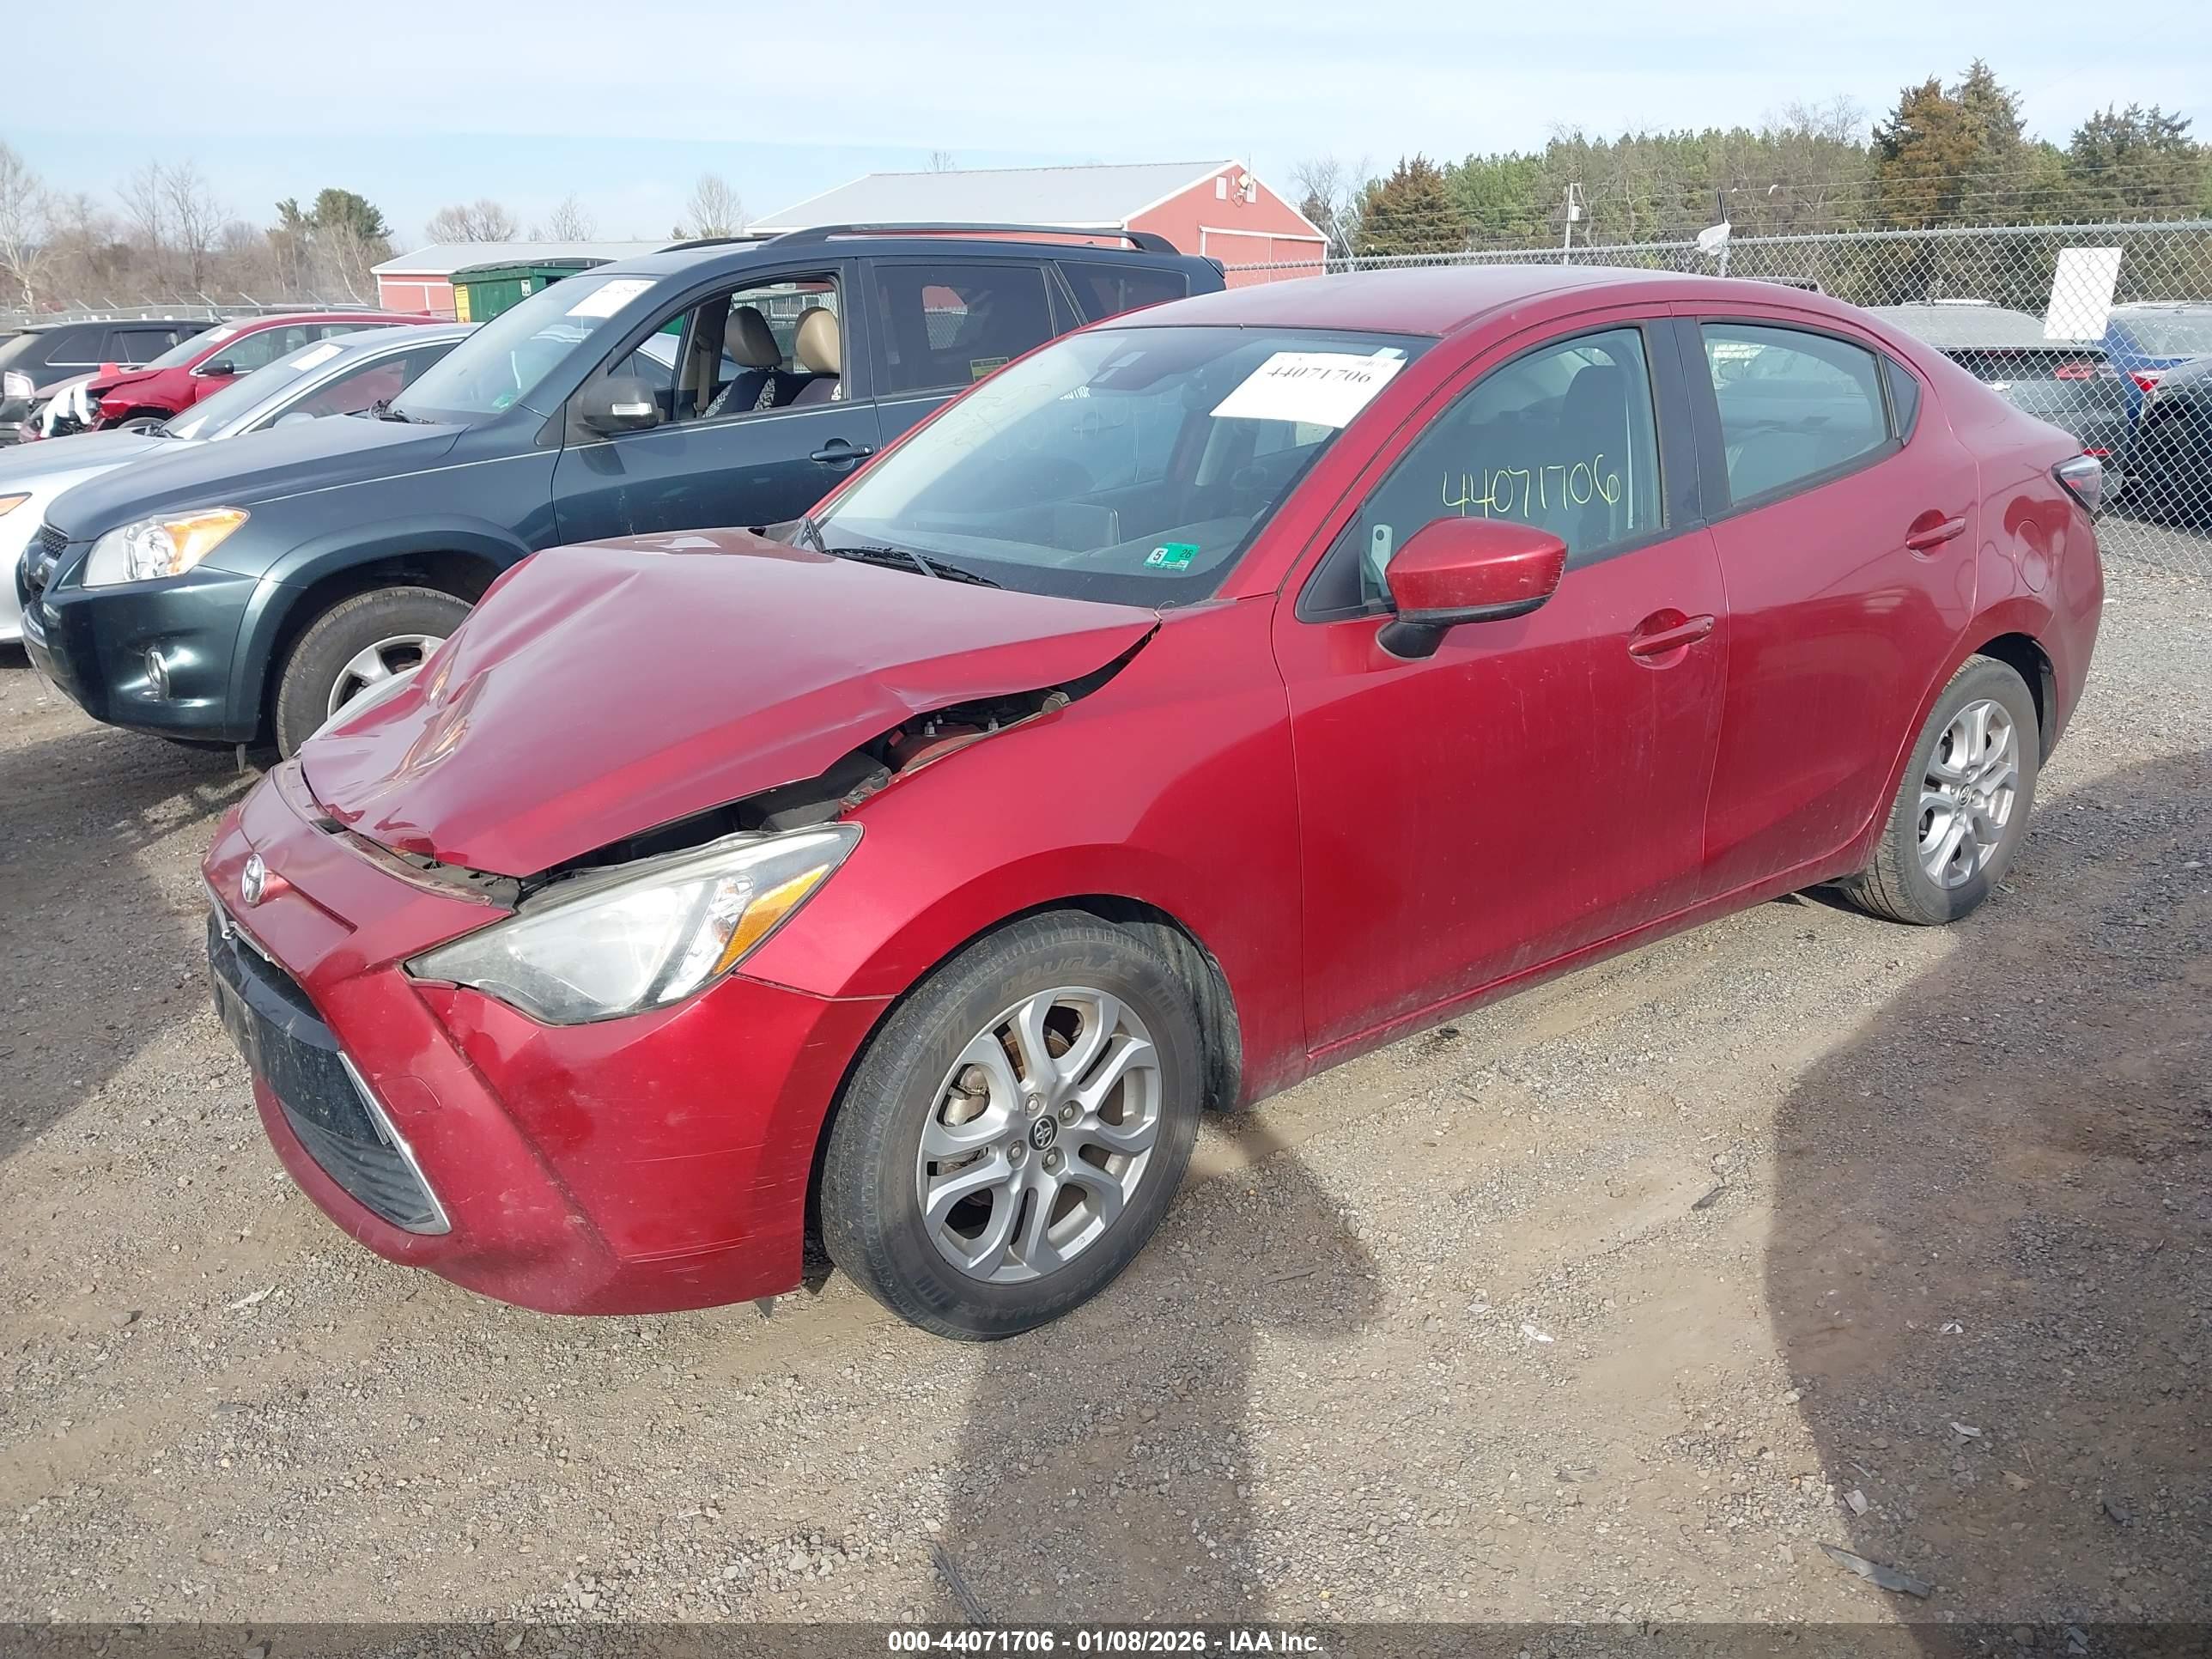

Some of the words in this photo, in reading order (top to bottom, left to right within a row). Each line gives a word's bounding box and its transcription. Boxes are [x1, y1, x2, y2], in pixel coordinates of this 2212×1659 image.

[1267, 366, 1372, 384] 44071706
[1442, 453, 1621, 519] 44071706
[1153, 550, 1164, 561] 5
[1180, 549, 1194, 558] 26
[1000, 955, 1140, 998] DOUGLAS
